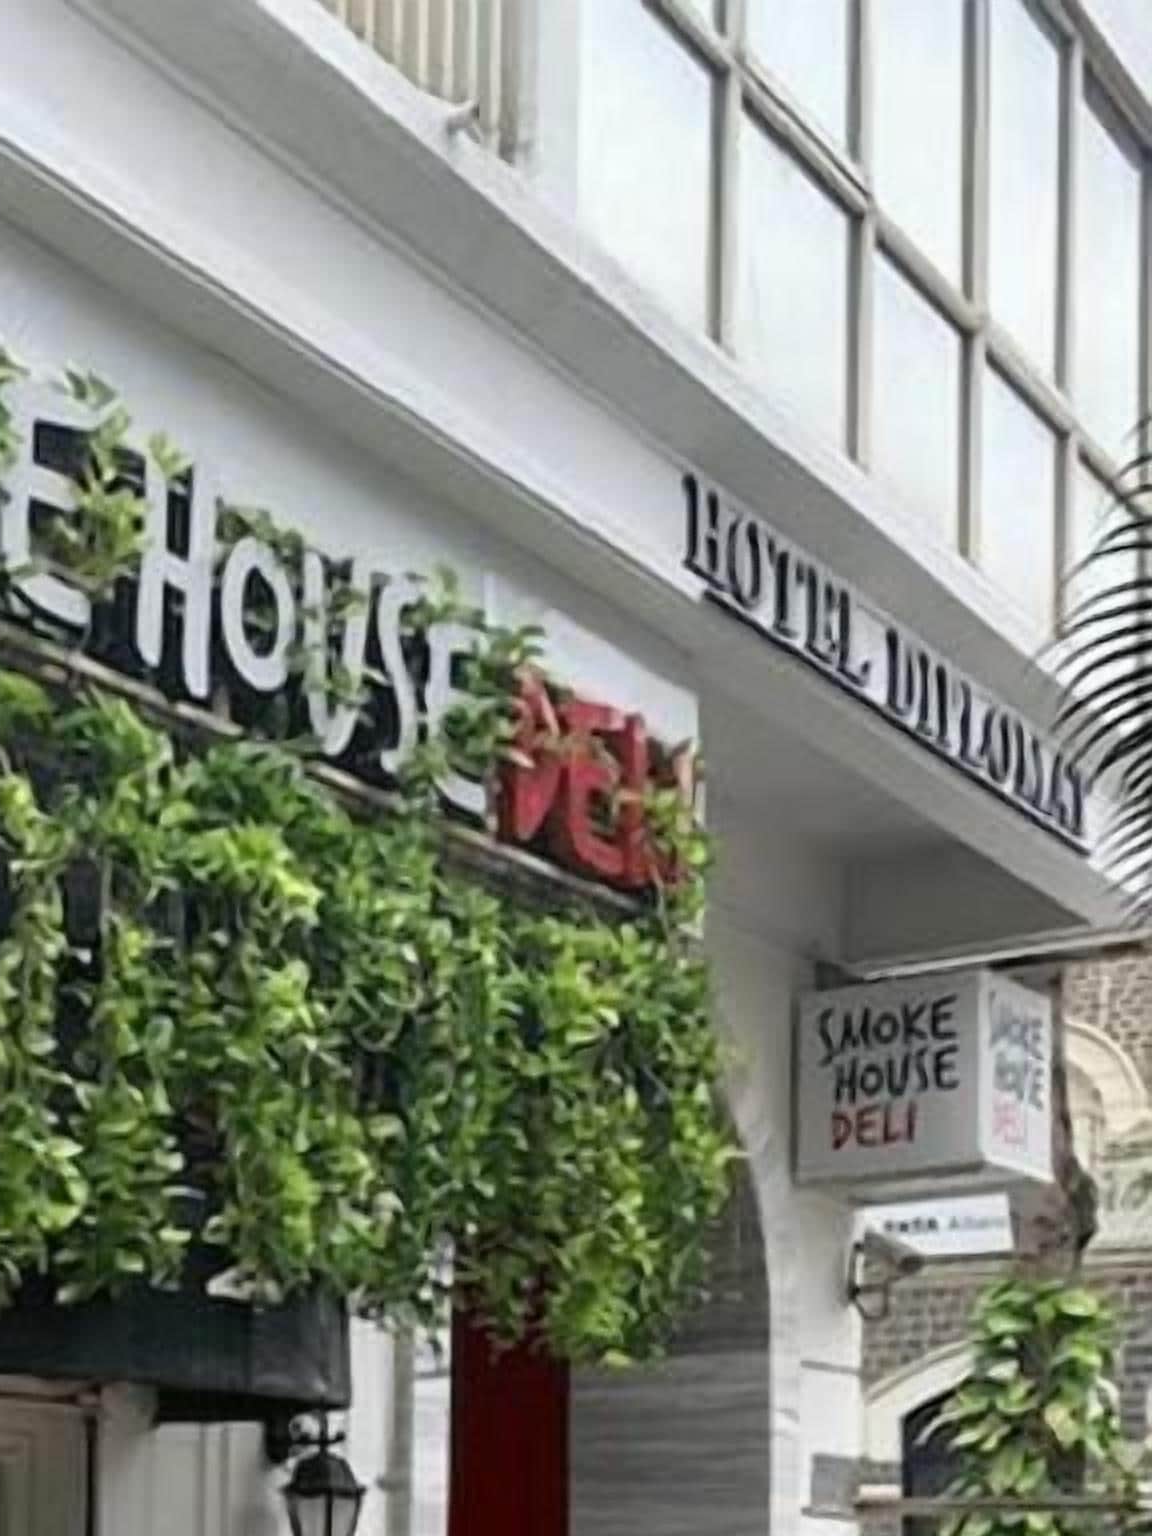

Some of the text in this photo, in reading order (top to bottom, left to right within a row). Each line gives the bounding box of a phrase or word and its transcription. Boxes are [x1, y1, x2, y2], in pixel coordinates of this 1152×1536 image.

[681, 472, 869, 689] HOTEL
[134, 458, 488, 812] HOUSE
[816, 993, 960, 1067] SMOKE
[833, 1044, 960, 1105] HOUSE
[830, 1101, 917, 1151] DELI
